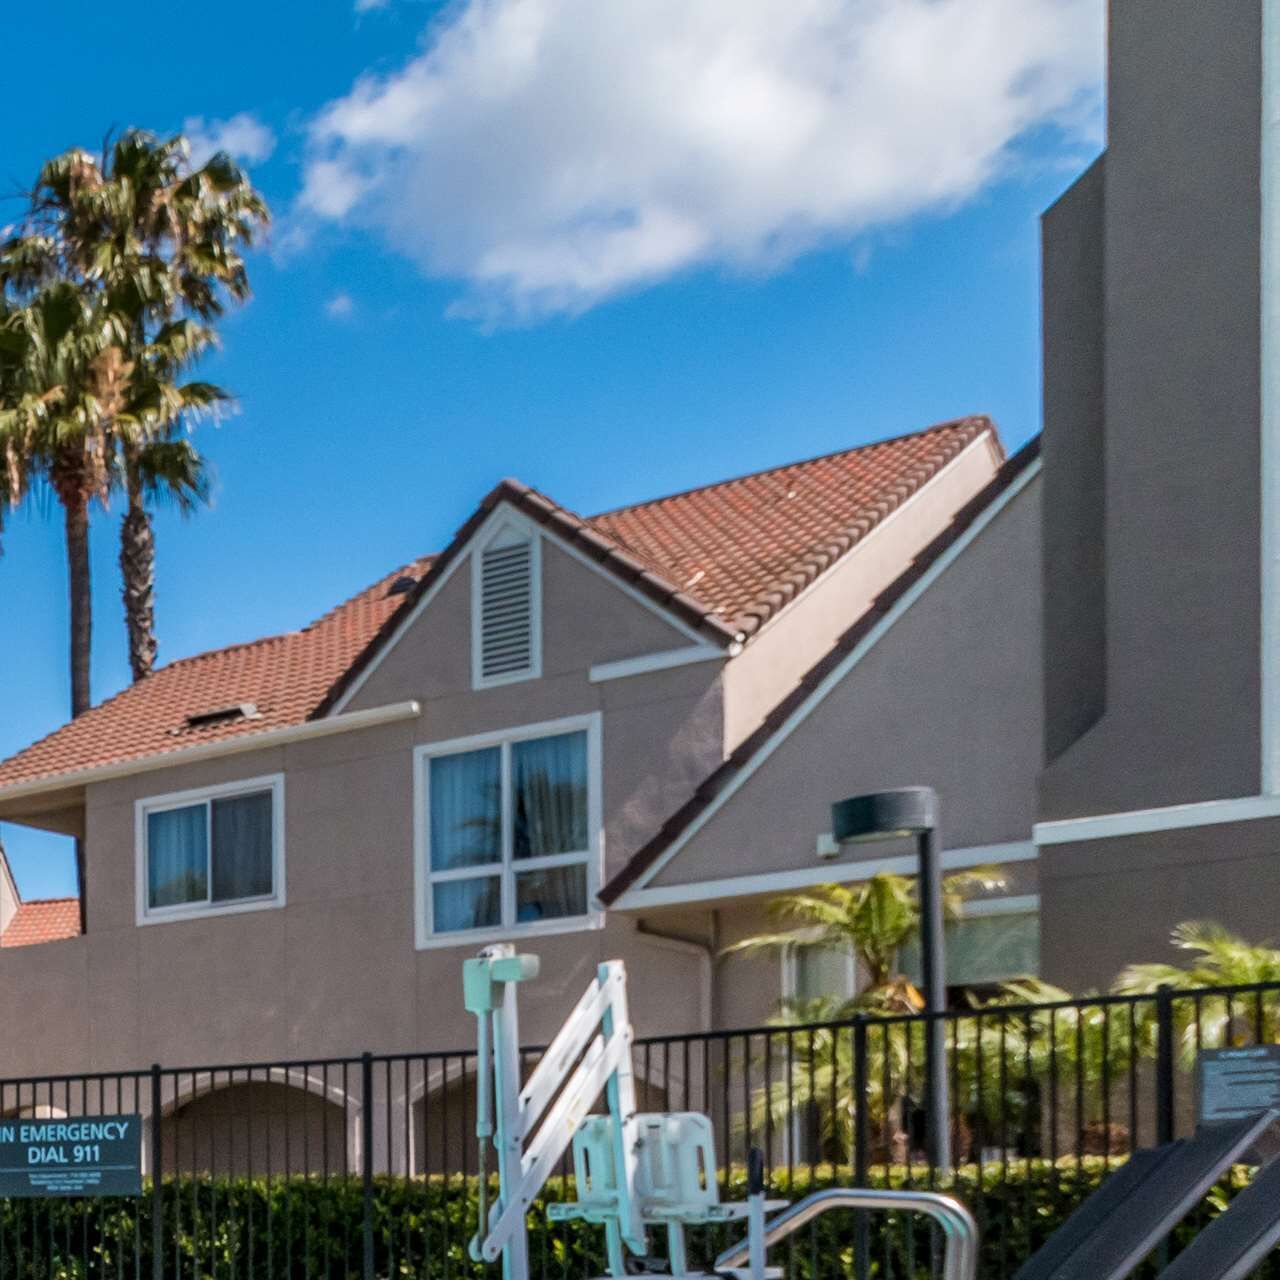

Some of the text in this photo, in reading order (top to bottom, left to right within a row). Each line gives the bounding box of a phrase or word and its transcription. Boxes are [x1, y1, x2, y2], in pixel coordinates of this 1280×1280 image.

[20, 1122, 128, 1143] EMERGENCY
[28, 1145, 100, 1164] DIAL 911
